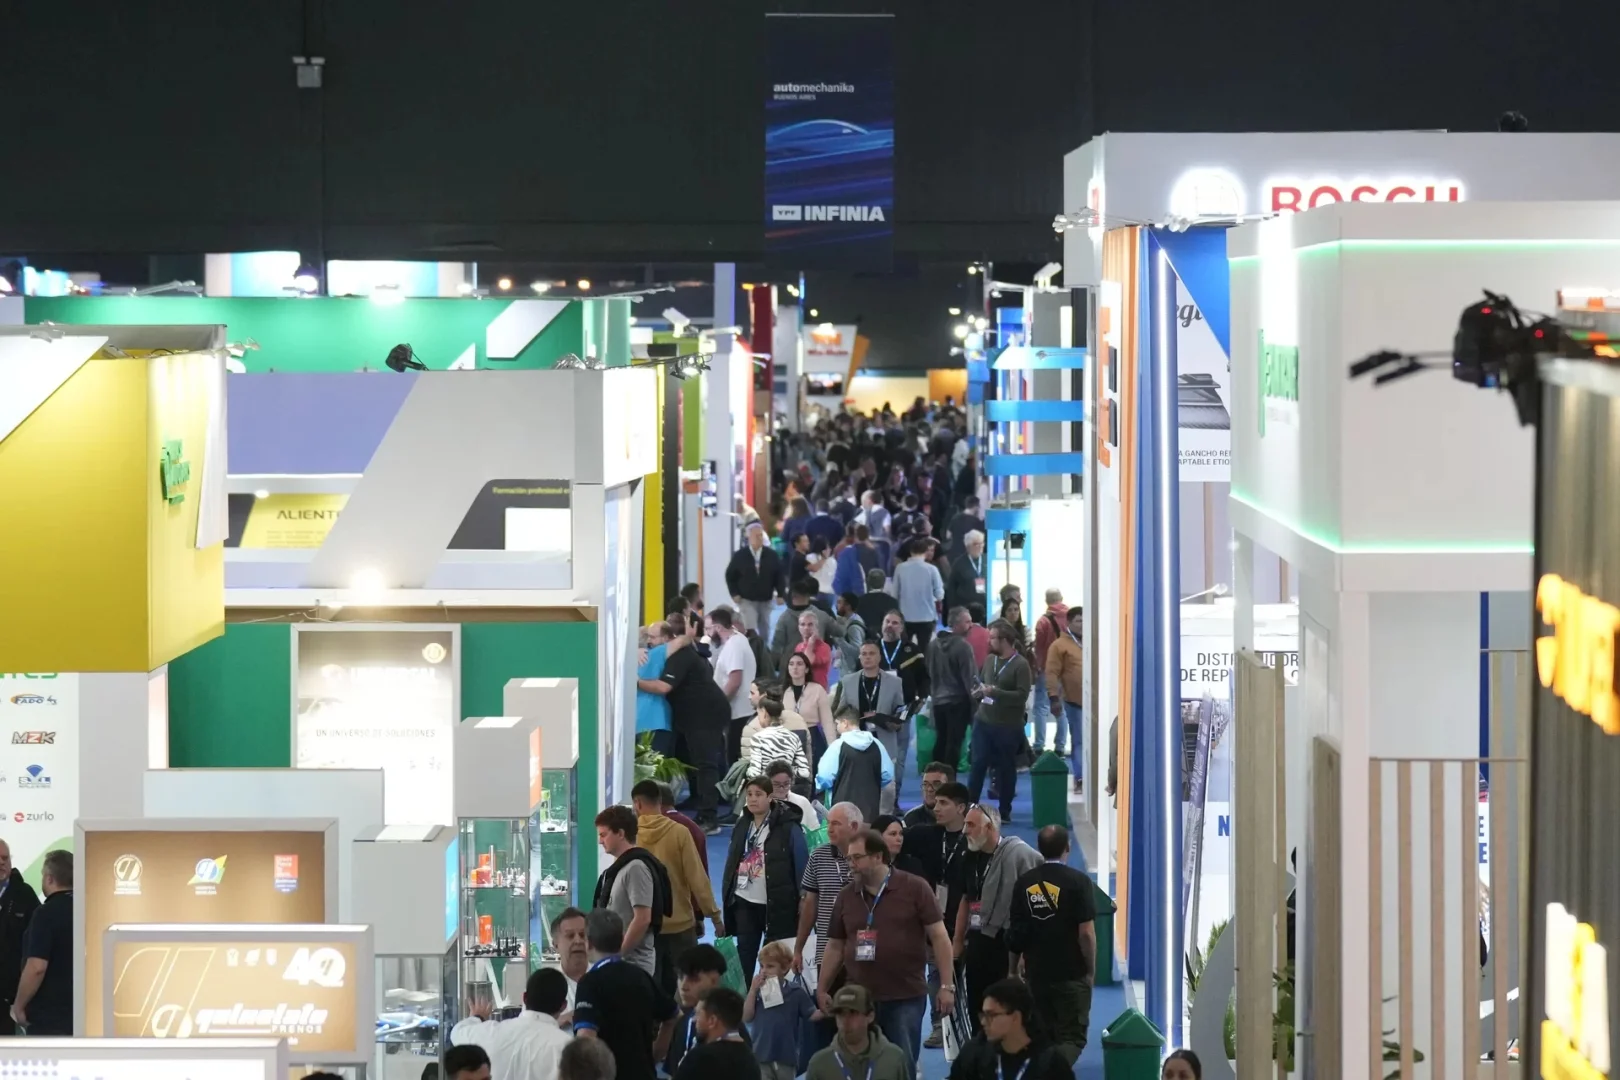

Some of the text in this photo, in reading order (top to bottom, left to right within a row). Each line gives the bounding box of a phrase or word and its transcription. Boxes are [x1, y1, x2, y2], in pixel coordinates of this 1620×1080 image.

[773, 82, 855, 93] automechanika
[804, 205, 885, 222] INFINIA
[12, 731, 56, 744] MZK
[27, 811, 54, 821] zurlo
